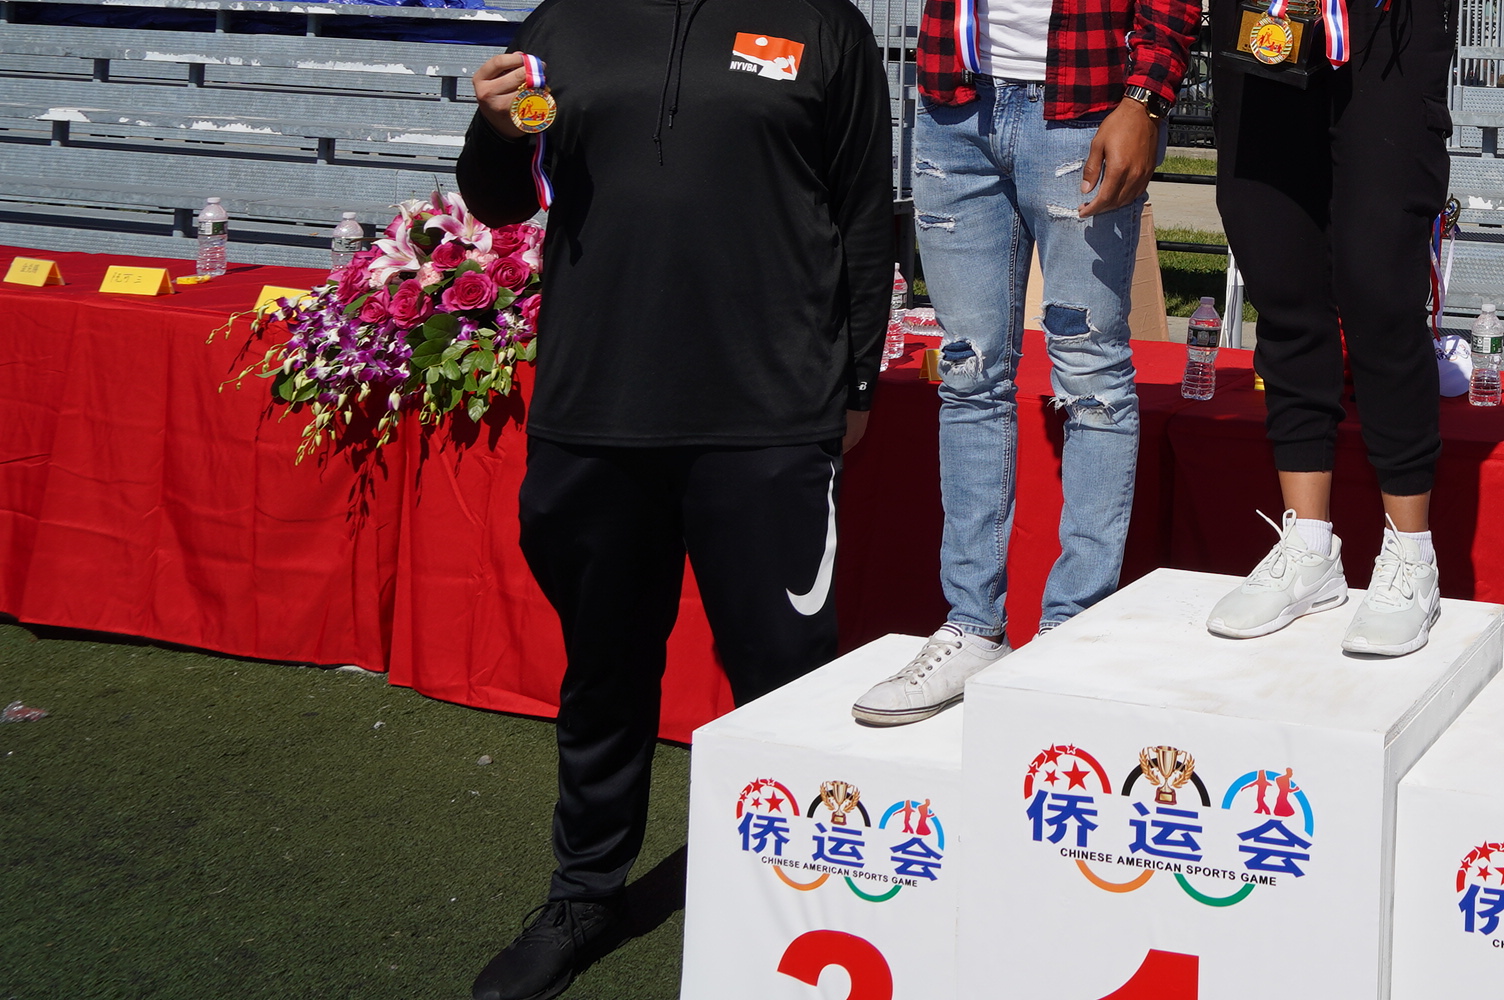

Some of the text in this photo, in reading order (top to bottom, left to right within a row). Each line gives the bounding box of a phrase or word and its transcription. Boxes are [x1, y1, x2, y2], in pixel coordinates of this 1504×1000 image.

[729, 60, 758, 73] NYVBA
[737, 811, 944, 881] 侨运会
[1026, 788, 1313, 878] 侨运会
[761, 856, 918, 888] CHINESE AMERICAN SPORTS GAME
[1059, 847, 1277, 886] CHINESE AMERICAN SPORTS GAME
